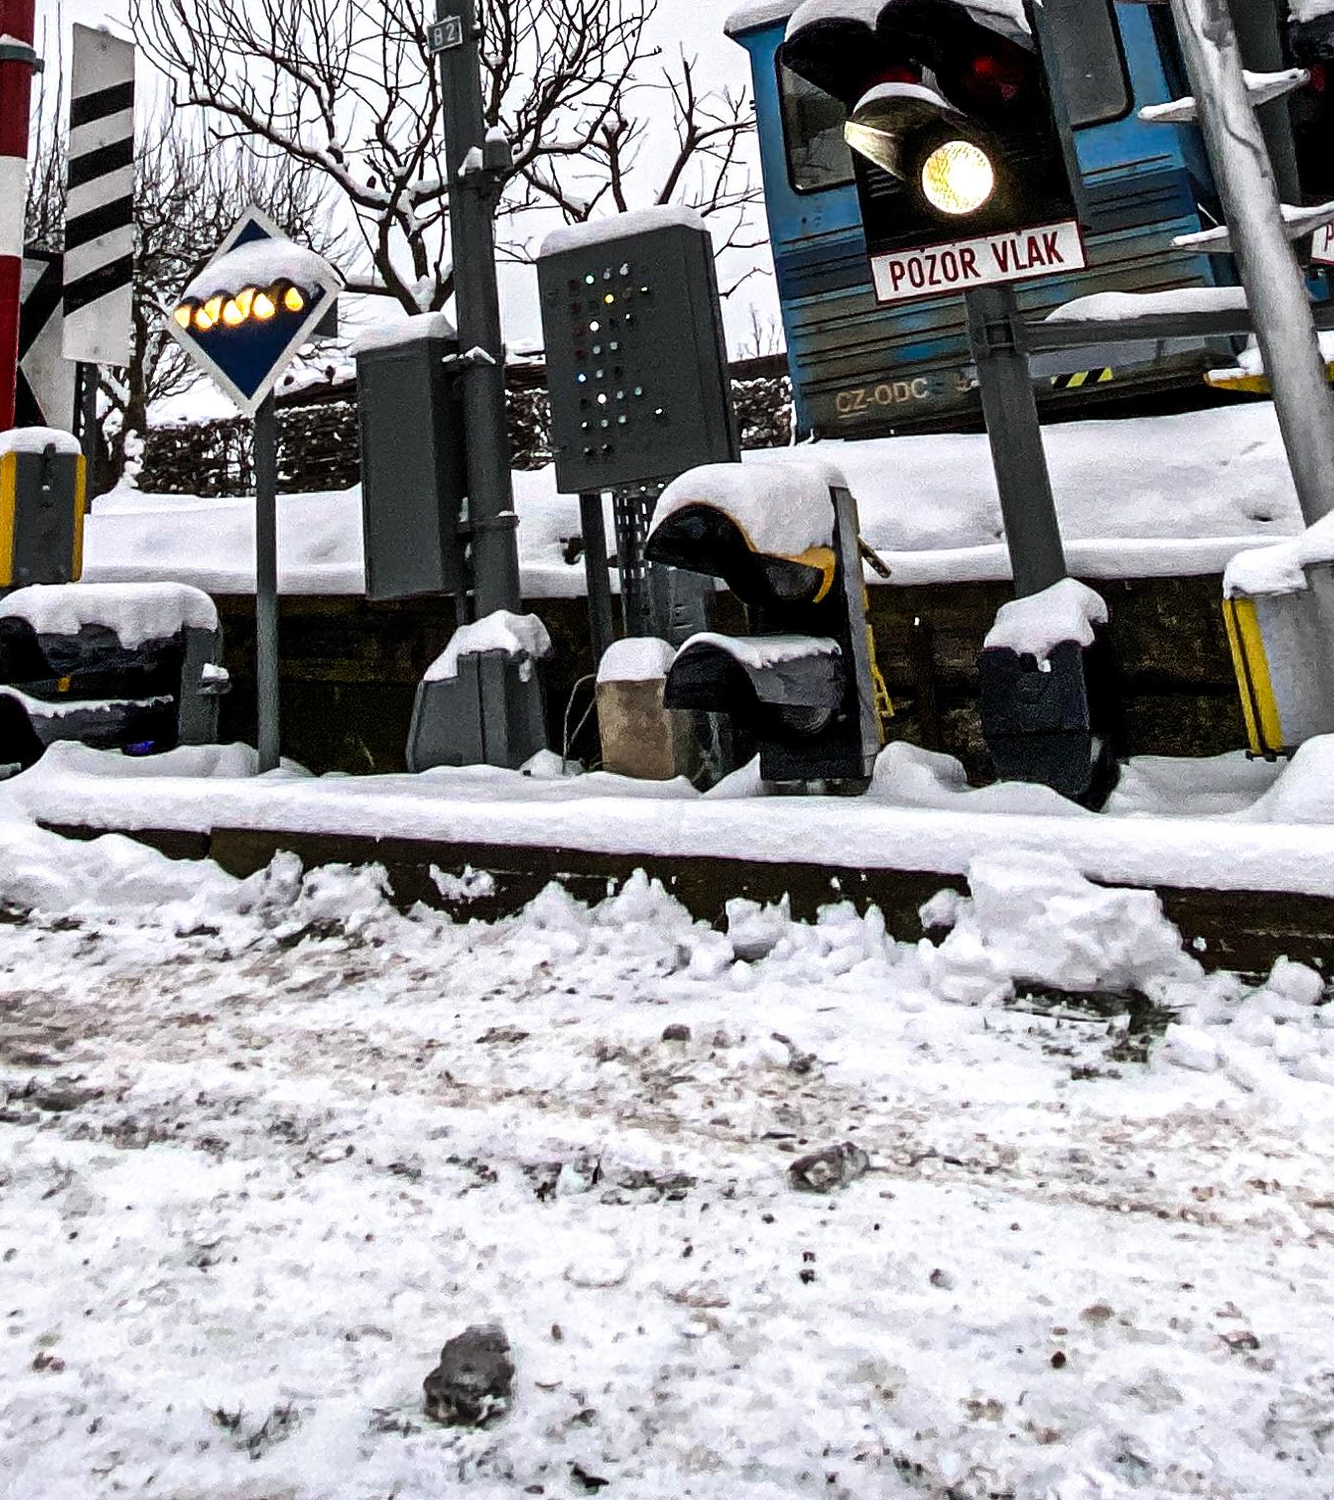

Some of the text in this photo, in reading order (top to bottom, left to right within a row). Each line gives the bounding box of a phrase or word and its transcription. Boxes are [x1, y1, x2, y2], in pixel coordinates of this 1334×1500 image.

[888, 231, 1064, 292] POZOR VLAK
[835, 377, 929, 413] CZ-ODC
